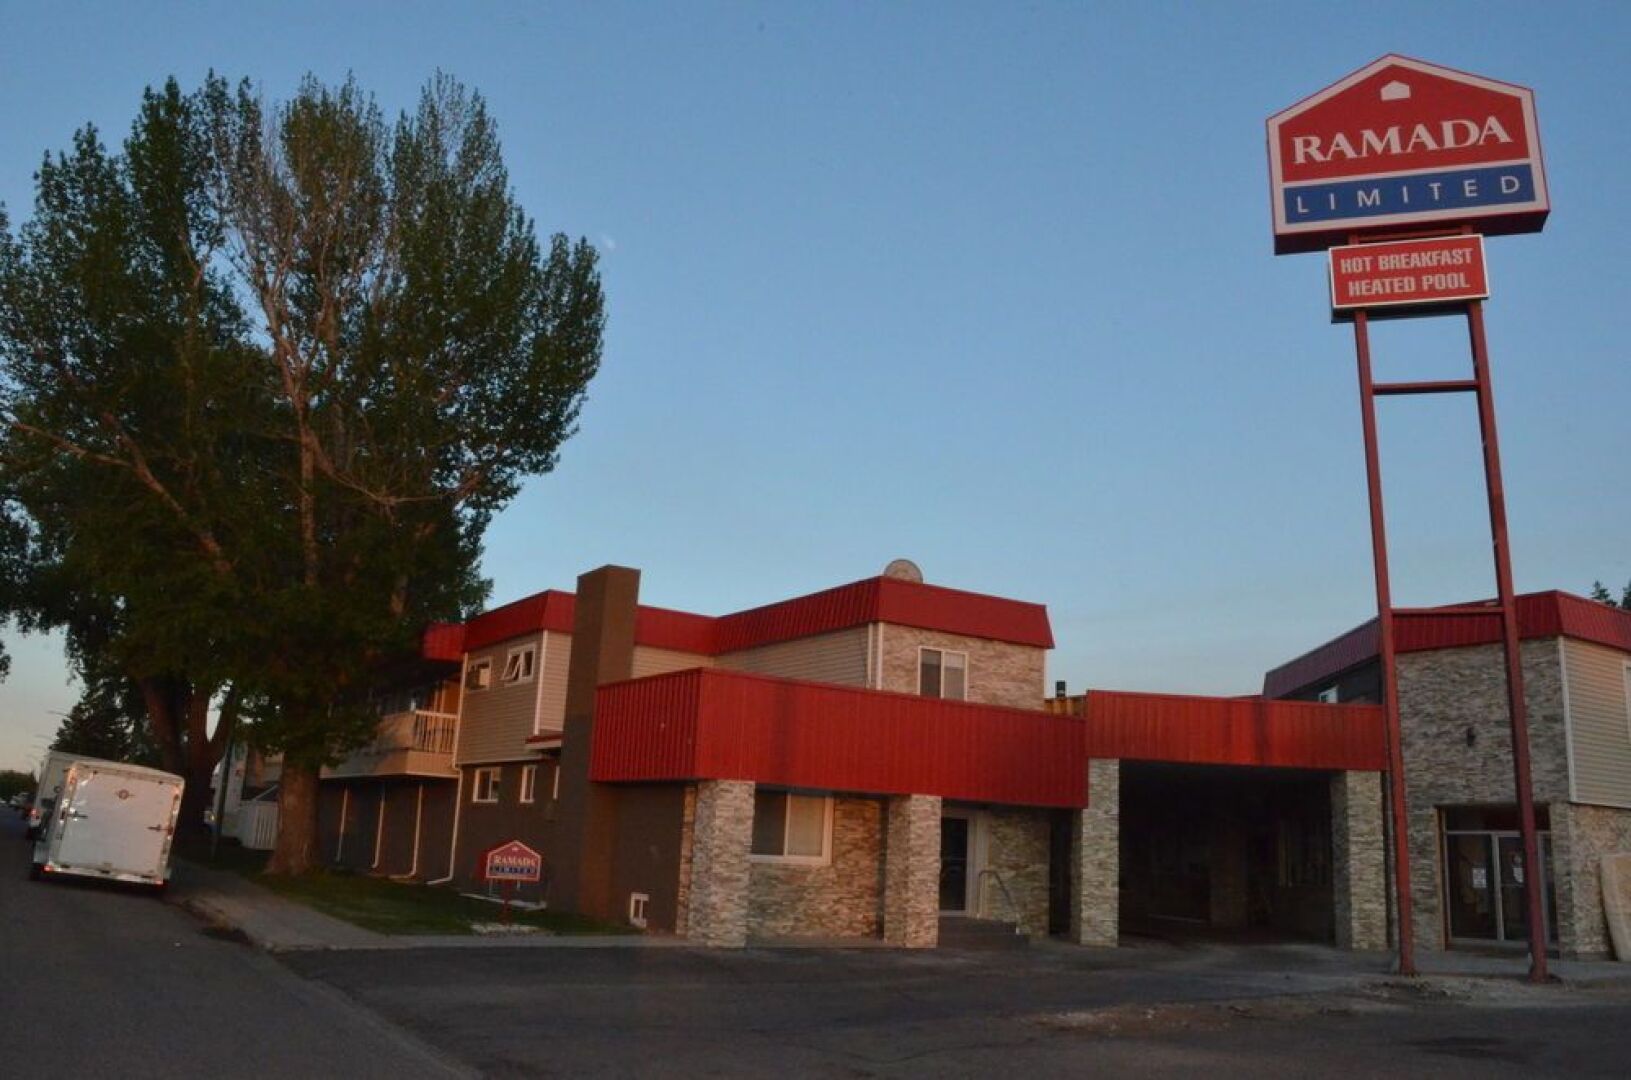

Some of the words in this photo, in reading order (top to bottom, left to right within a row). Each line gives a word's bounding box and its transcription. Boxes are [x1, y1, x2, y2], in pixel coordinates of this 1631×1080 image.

[1293, 115, 1512, 163] RAMADA
[1297, 175, 1519, 212] LIMITED
[1340, 256, 1373, 274] HOT
[1378, 248, 1473, 271] BREAKFAST
[1348, 276, 1415, 297] HEATED
[1422, 272, 1470, 291] POOL
